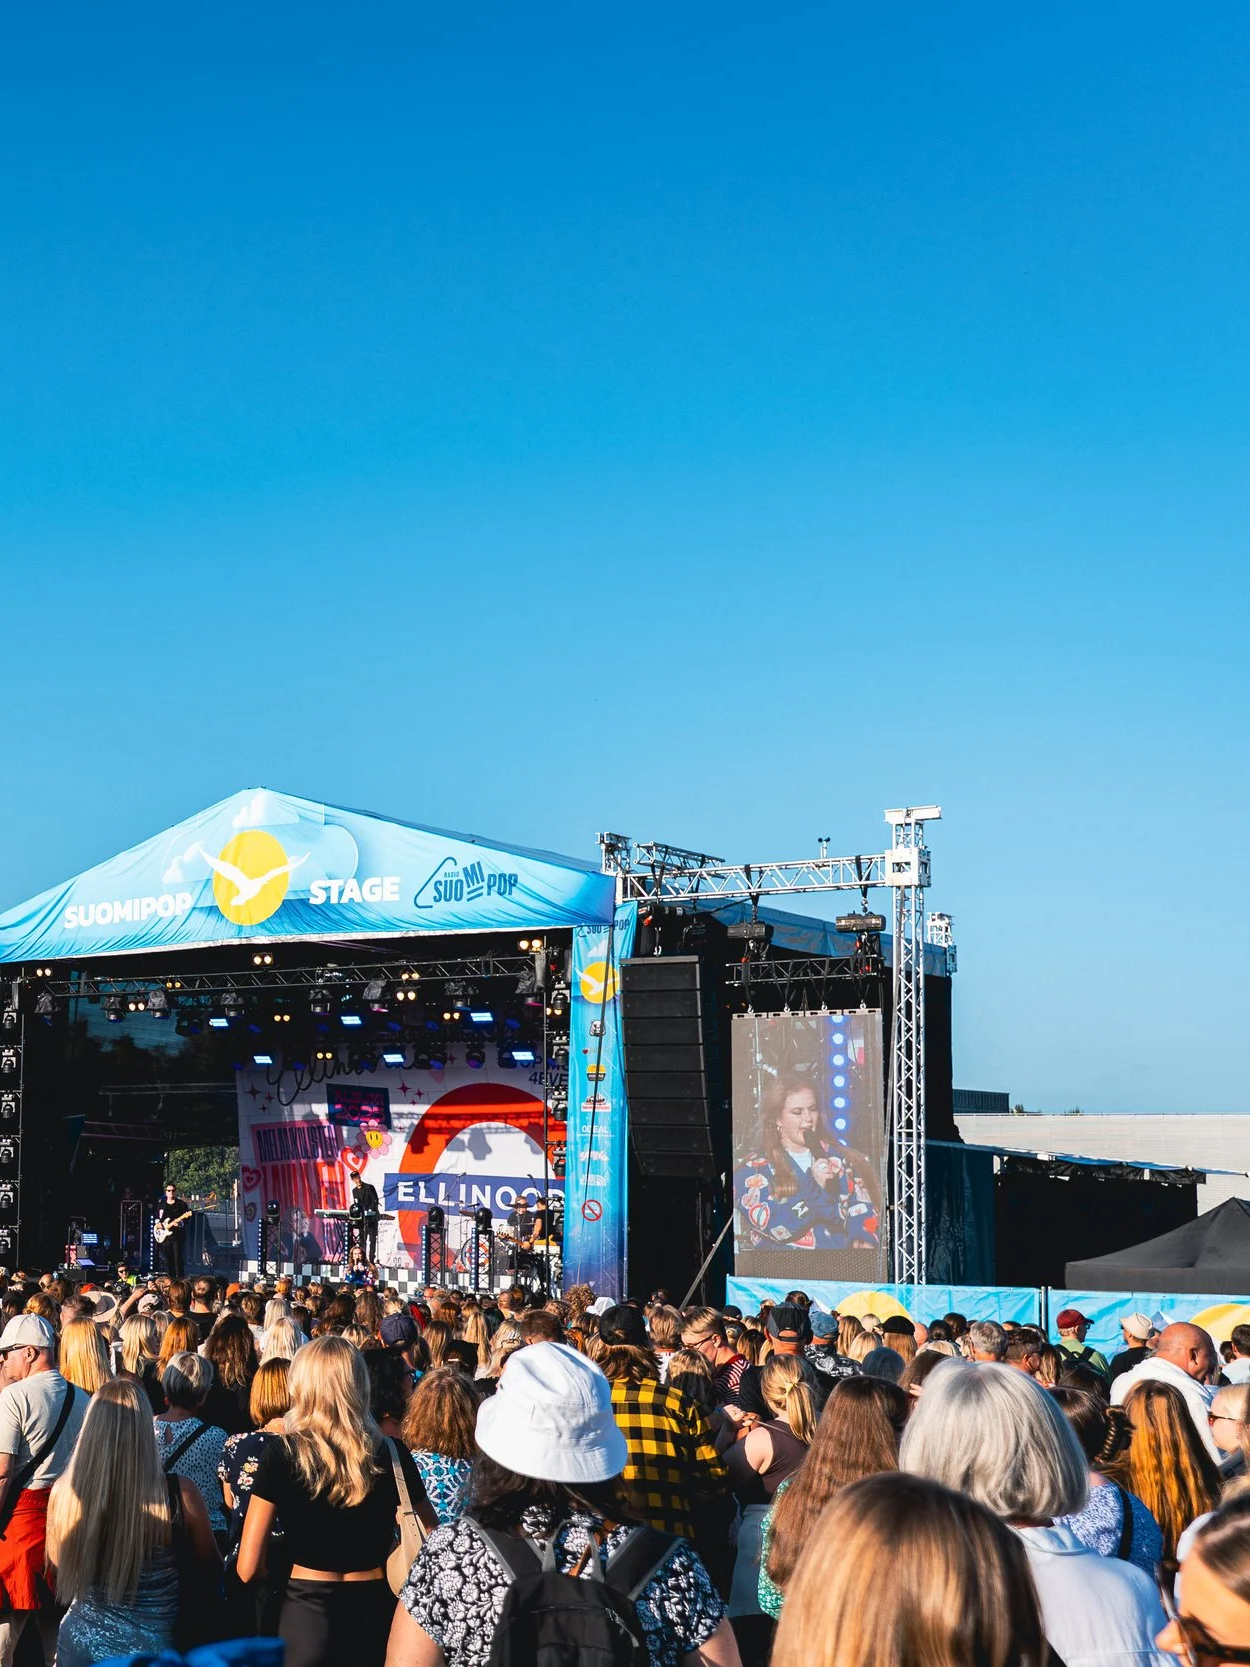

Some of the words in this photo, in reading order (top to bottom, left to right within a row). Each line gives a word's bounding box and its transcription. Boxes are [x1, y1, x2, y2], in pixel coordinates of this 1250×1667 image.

[63, 892, 194, 929] SUOMIPOP
[309, 875, 401, 905] STAGE
[433, 879, 463, 902] SUO
[462, 861, 485, 888] MI
[486, 873, 518, 896] POP
[334, 1102, 385, 1123] 2025
